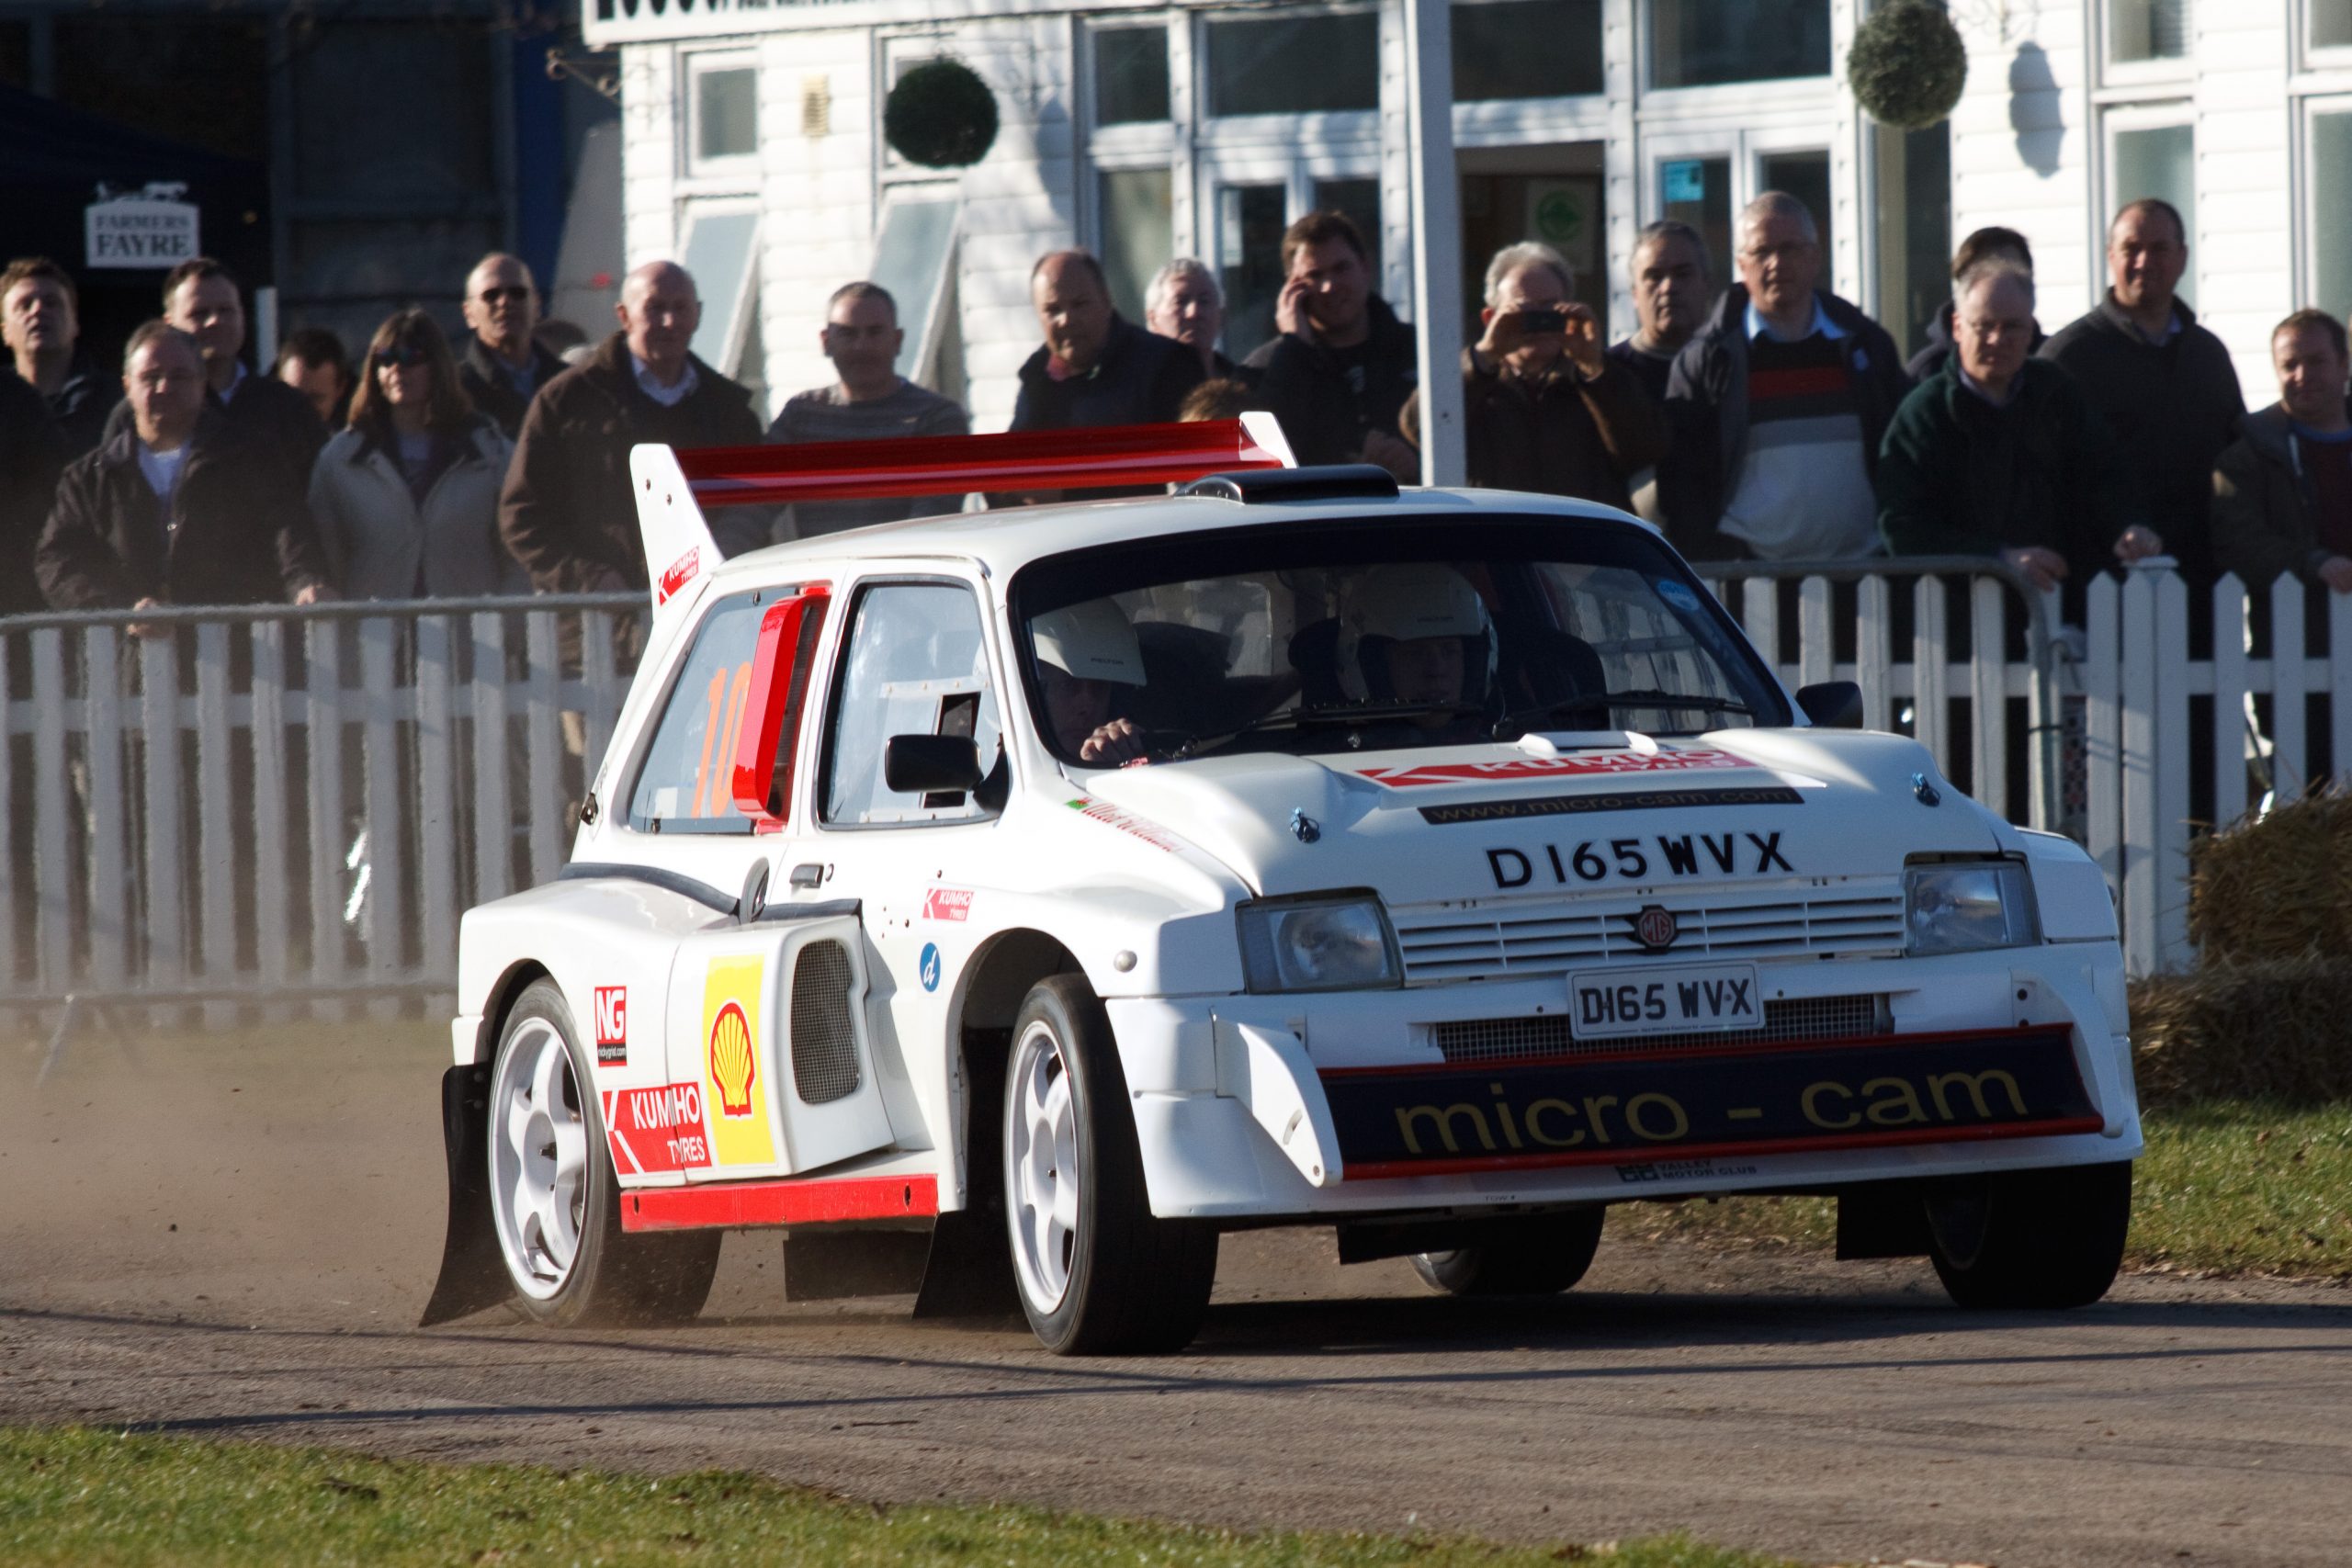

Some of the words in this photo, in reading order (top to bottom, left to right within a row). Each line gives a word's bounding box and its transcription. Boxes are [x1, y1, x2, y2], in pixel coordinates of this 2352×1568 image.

[95, 214, 191, 230] FARMERS
[96, 233, 192, 257] FAYRE
[669, 547, 698, 582] KUMHO
[691, 660, 753, 819] 10
[1471, 749, 1730, 773] KUMHO
[1602, 759, 1736, 772] TYRES
[1431, 788, 1793, 822] www.micro-cam.com
[939, 889, 972, 907] KUMHO
[1643, 912, 1670, 942] MG
[595, 989, 625, 1041] NG
[1579, 984, 1666, 1025] D165
[1678, 978, 1753, 1019] WVX
[630, 1086, 701, 1130] KUMHO
[1394, 1082, 1690, 1154] micro
[1800, 1069, 2028, 1130] cam
[667, 1136, 706, 1165] TYRES
[1657, 1160, 1711, 1171] VALLEY
[1663, 1168, 1713, 1179] MOTOR
[1718, 1165, 1757, 1177] CLUB
